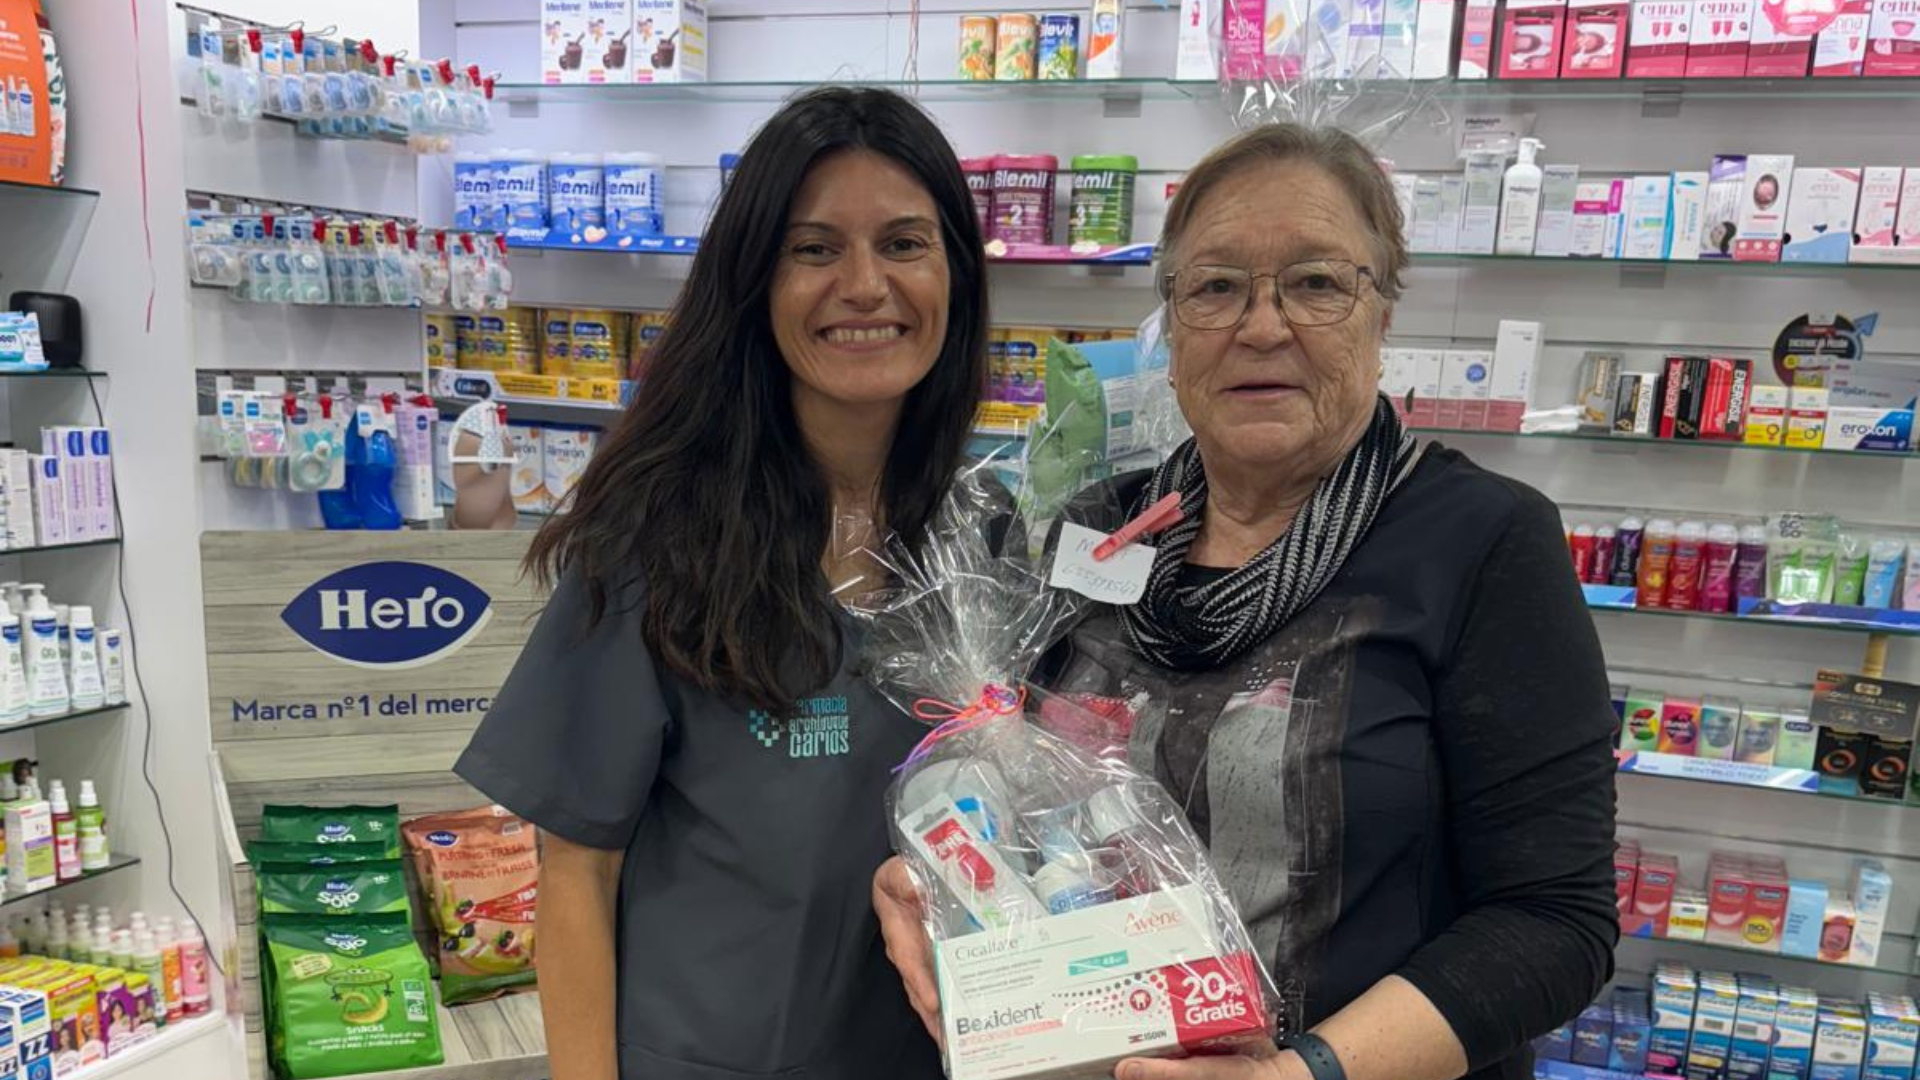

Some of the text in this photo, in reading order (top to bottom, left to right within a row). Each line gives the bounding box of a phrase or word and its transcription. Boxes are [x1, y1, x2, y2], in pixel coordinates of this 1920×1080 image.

[994, 170, 1048, 189] Blemil
[318, 586, 465, 630] Hero
[232, 700, 318, 723] Marca
[379, 693, 418, 716] del
[426, 696, 496, 714] merc
[957, 1003, 1041, 1036] Bexident
[1185, 998, 1247, 1026] Gratis
